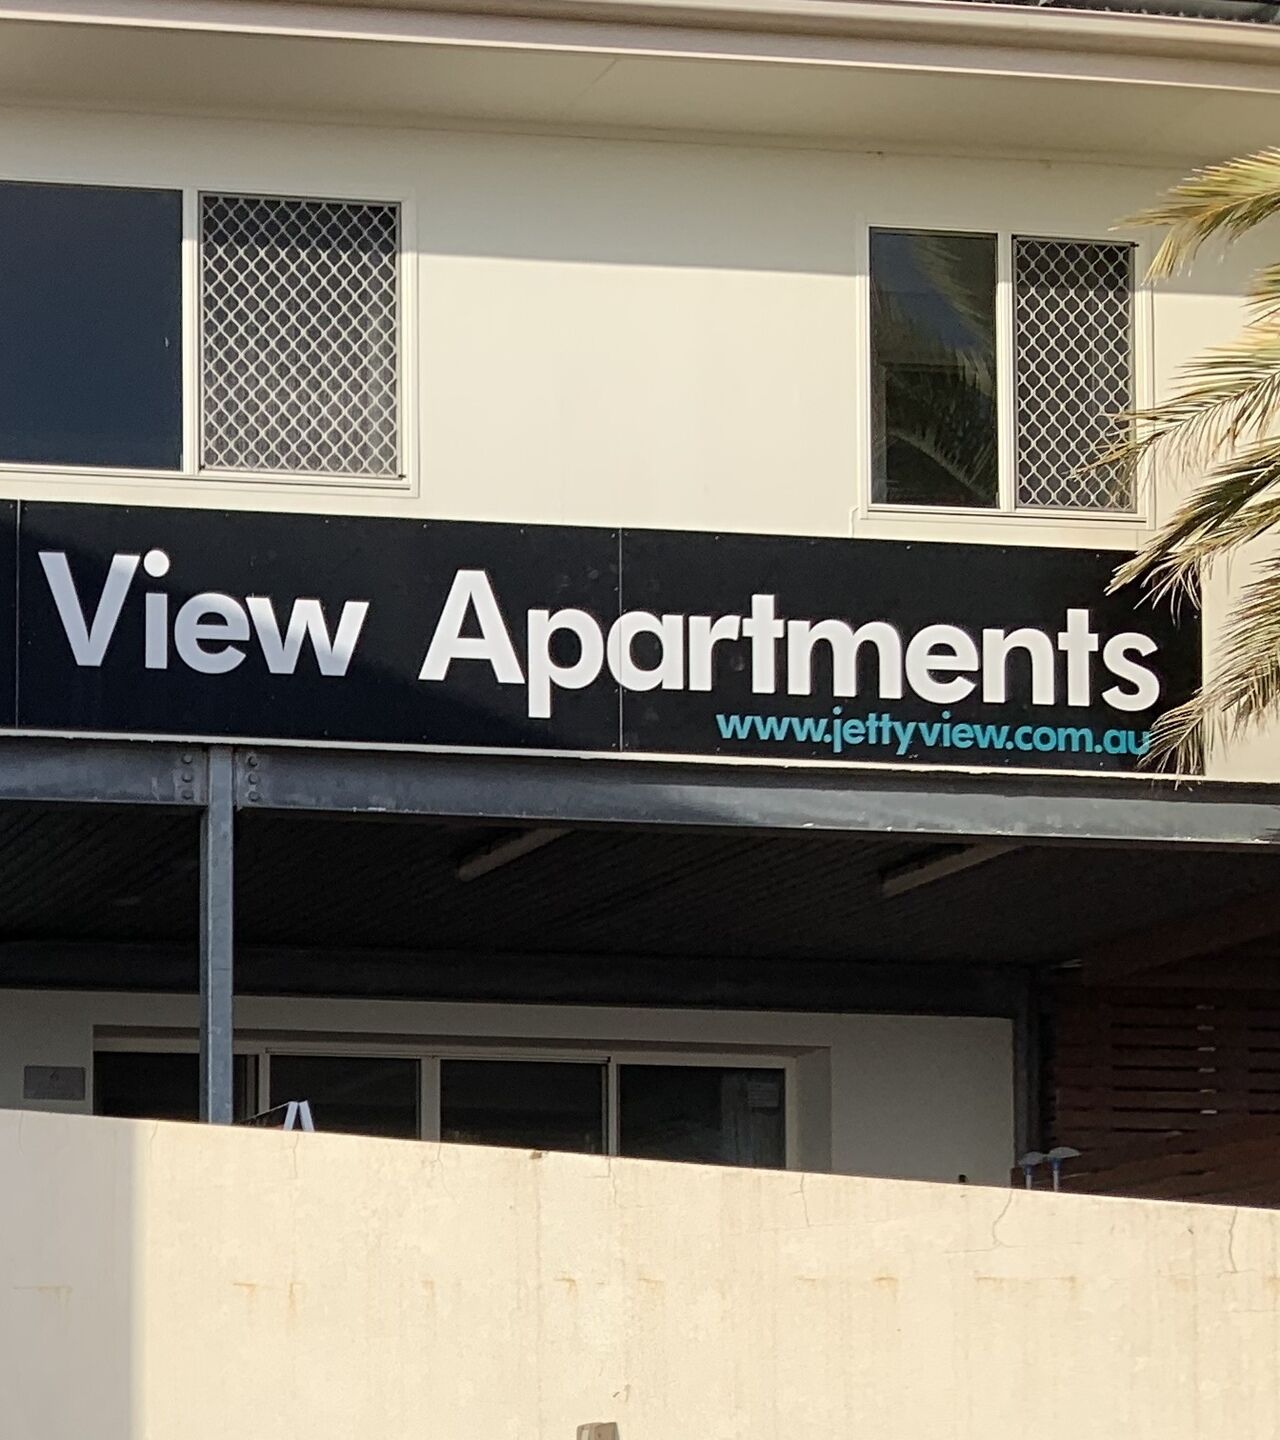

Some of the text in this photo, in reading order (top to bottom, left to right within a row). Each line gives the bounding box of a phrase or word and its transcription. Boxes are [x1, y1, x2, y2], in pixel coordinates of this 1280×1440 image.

[38, 549, 370, 677] View
[418, 568, 1162, 719] Apartments
[715, 705, 1151, 756] www.jettyview.com.au
